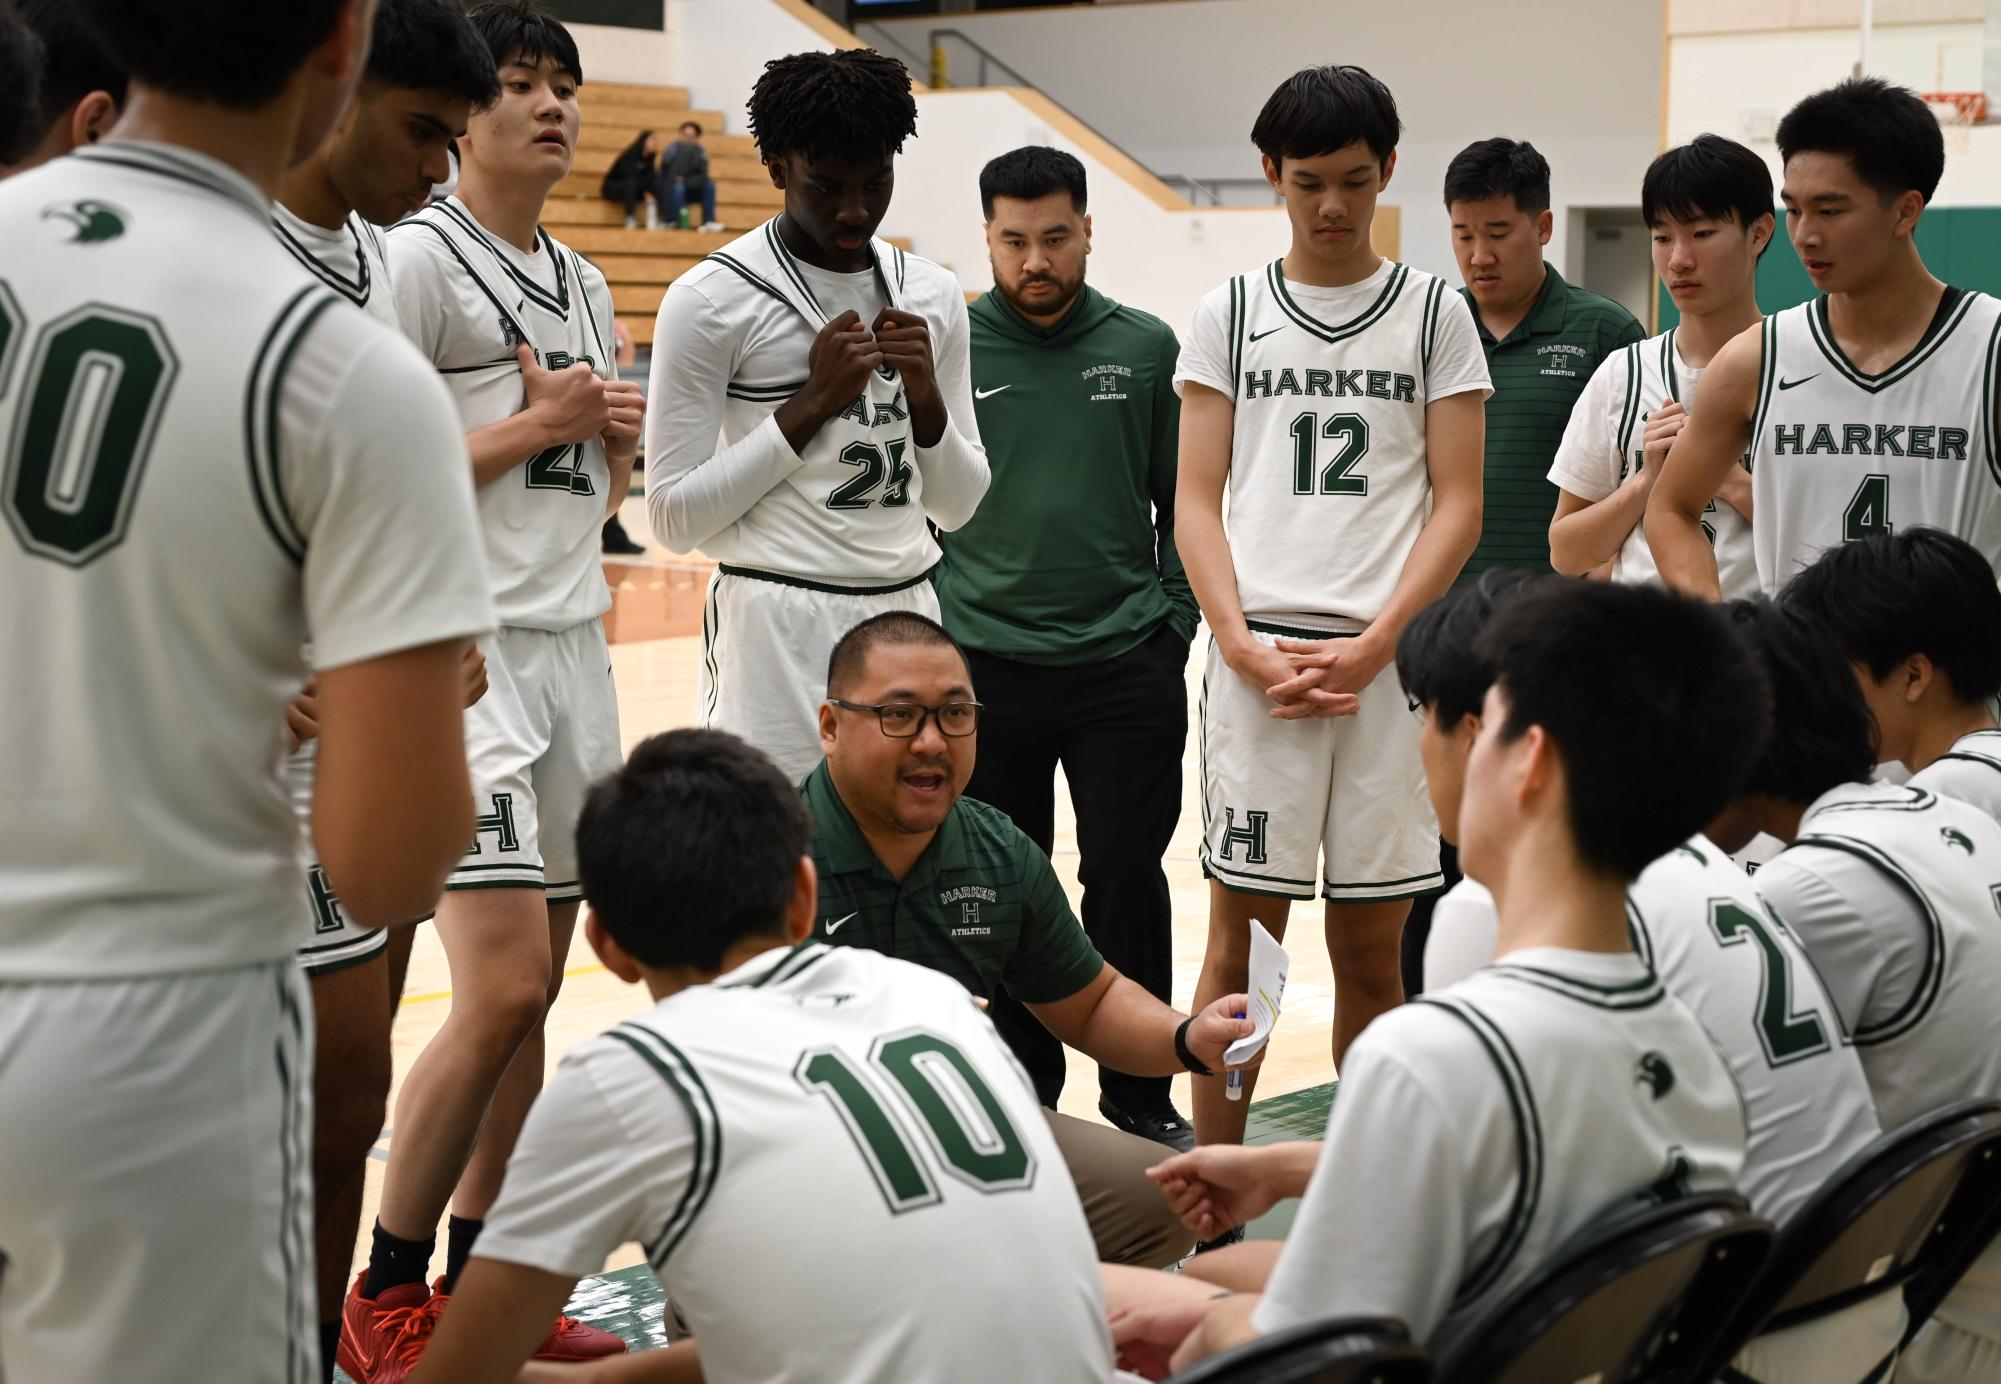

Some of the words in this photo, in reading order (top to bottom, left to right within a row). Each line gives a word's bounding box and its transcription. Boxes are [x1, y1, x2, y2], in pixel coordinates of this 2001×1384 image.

[1537, 344, 1586, 358] HARKER
[1551, 354, 1567, 368] H
[1081, 364, 1132, 380] HARKER
[1099, 375, 1117, 391] H
[1540, 369, 1576, 377] ATHLETICS
[1245, 368, 1417, 403] HARKER
[1090, 393, 1127, 401] ATHLETICS
[0, 277, 182, 570] 0
[1775, 424, 1969, 460] HARKER
[1290, 411, 1370, 496] 12
[826, 437, 913, 509] 25
[1842, 473, 1893, 543] 4
[1220, 807, 1268, 864] H
[940, 886, 997, 905] HARKER
[962, 902, 980, 924] H
[951, 927, 991, 936] ATHLETICS
[791, 1024, 1038, 1216] 10
